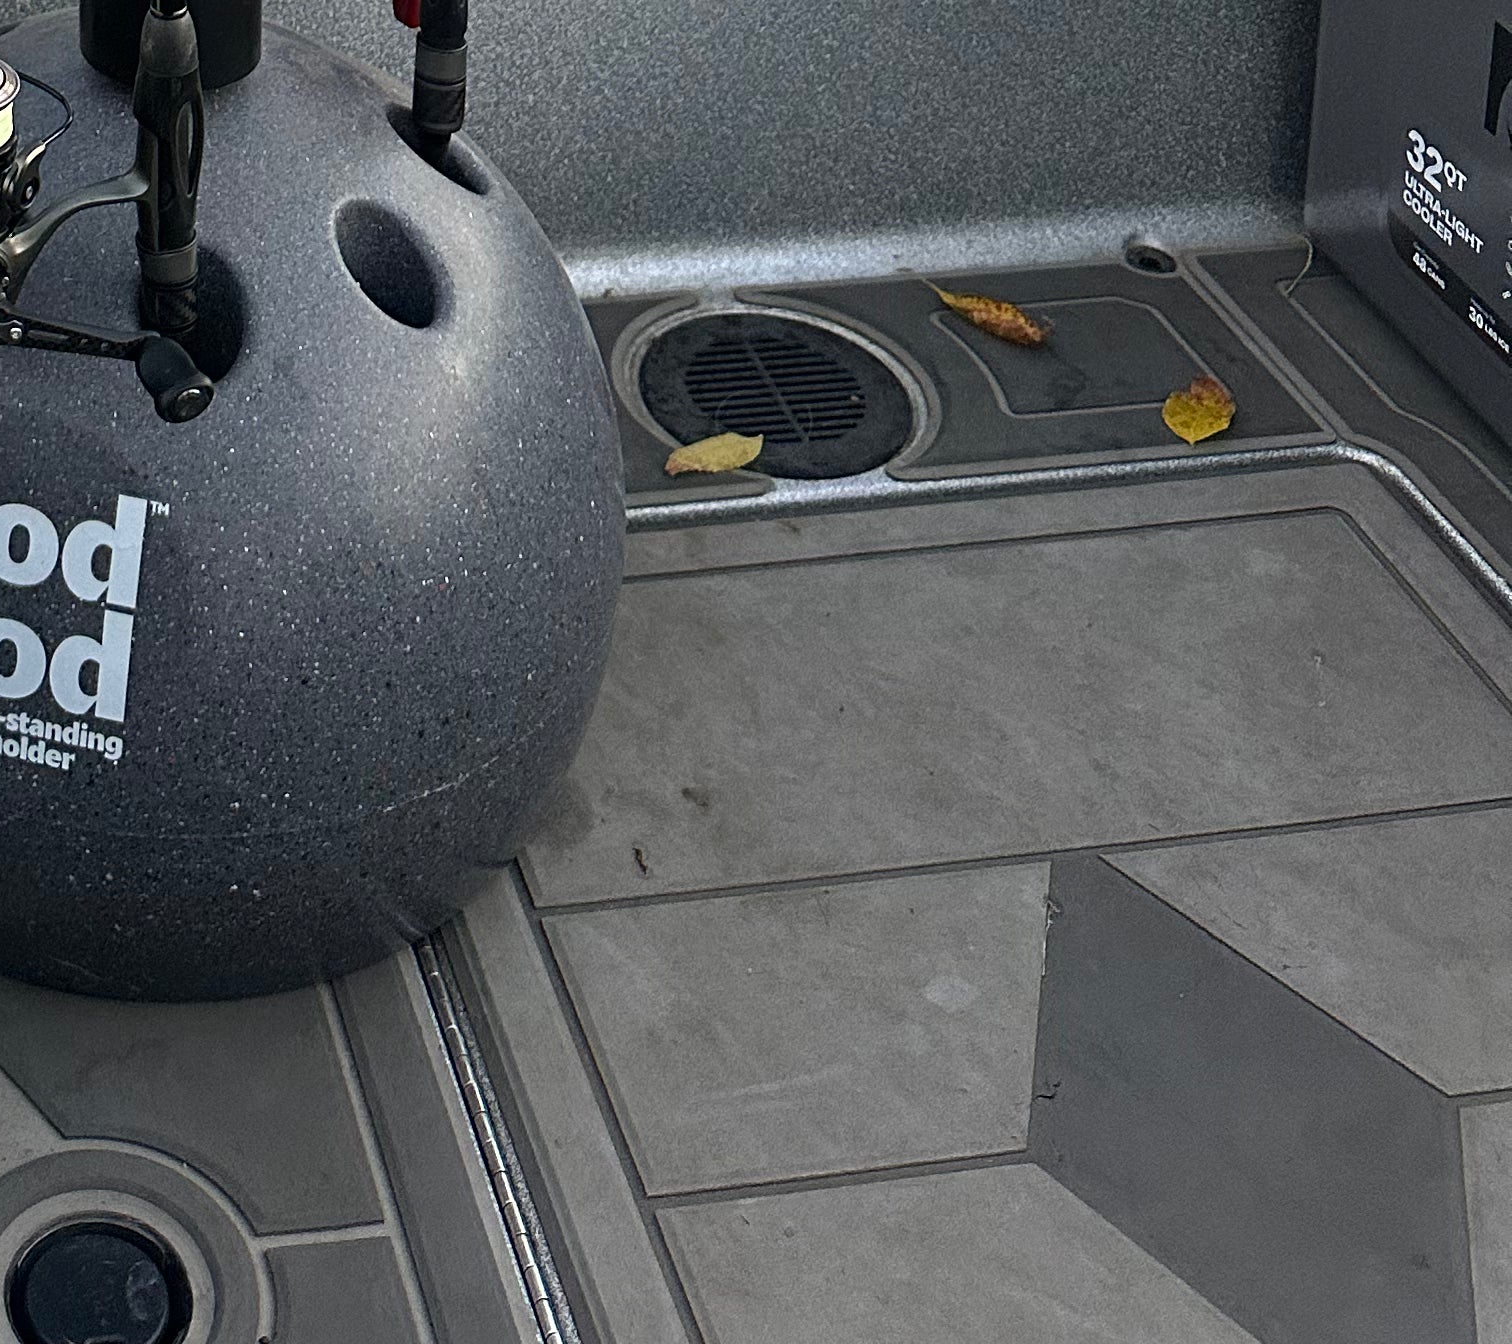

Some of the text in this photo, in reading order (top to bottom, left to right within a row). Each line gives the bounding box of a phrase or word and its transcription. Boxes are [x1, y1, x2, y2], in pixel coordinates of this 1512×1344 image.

[1403, 189, 1454, 247] COOLER
[1404, 170, 1484, 254] ULTRA-LIGHT
[1468, 305, 1485, 330] 30
